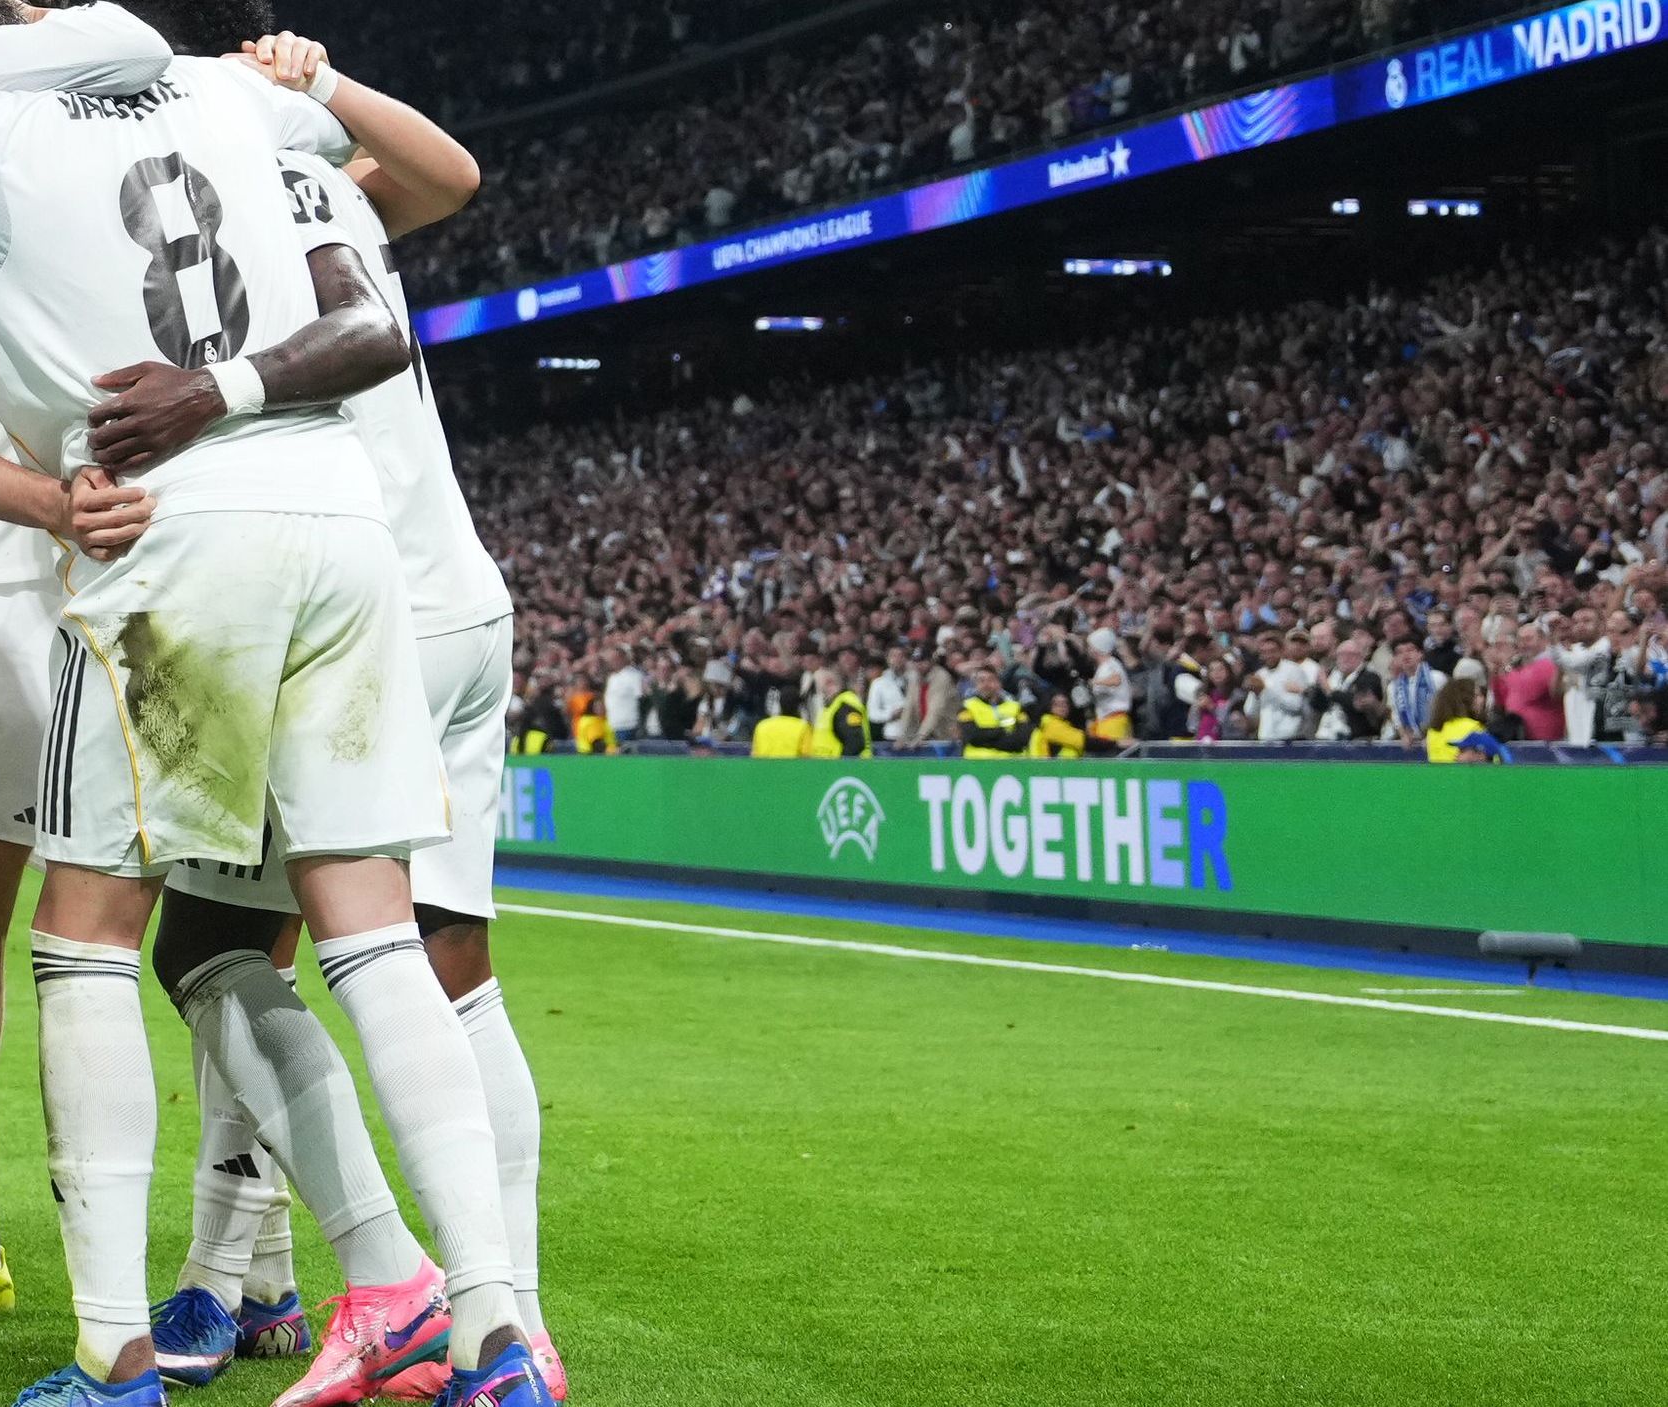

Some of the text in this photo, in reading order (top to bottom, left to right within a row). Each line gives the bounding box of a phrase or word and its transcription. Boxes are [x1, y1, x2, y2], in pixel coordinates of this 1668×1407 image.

[1414, 32, 1504, 99] REAL
[119, 151, 250, 370] 8
[918, 774, 1233, 891] TOGETHER
